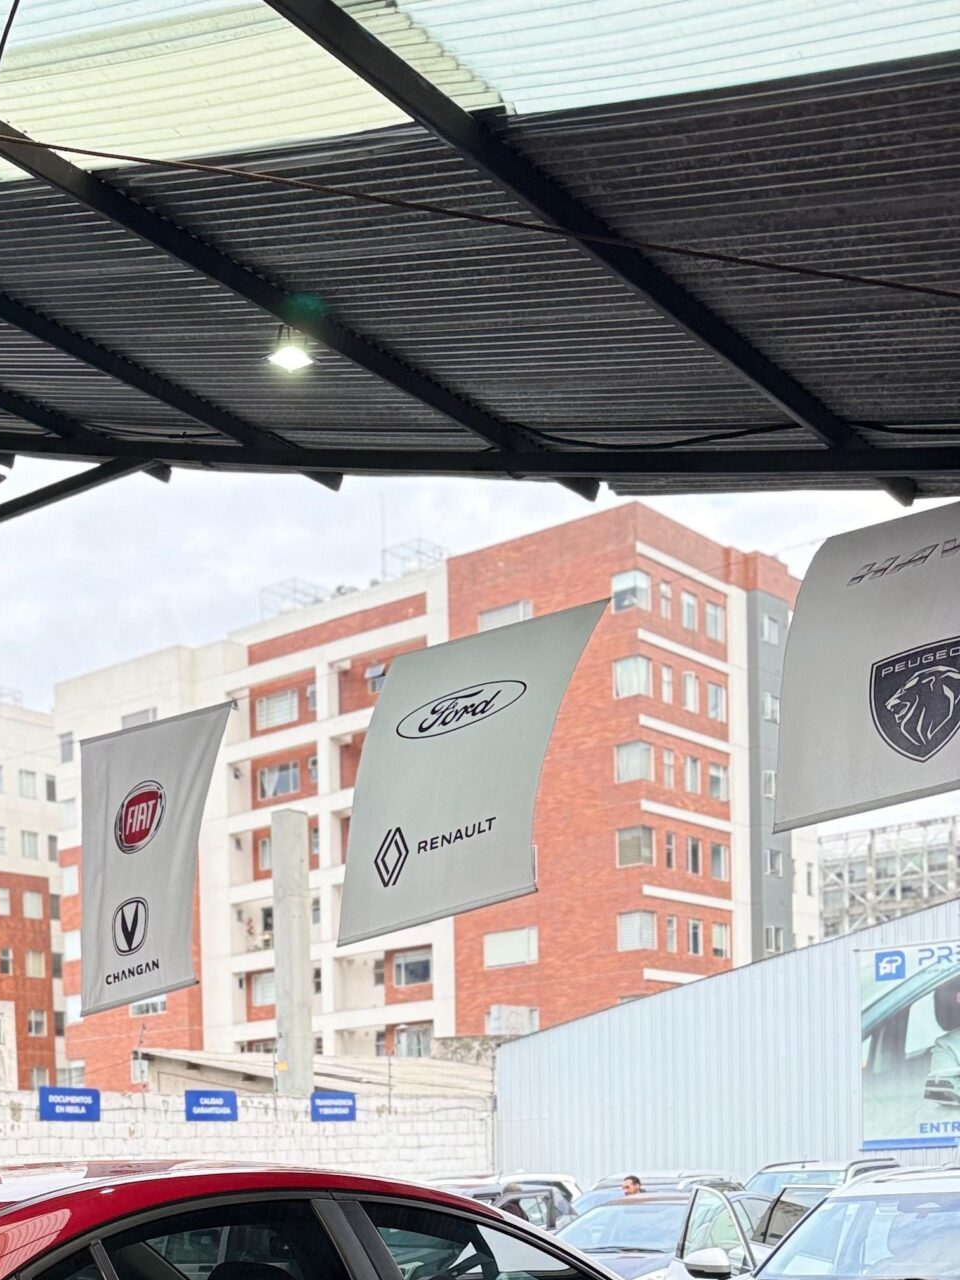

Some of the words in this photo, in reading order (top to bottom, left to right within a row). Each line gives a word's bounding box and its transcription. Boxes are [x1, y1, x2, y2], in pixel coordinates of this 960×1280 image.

[417, 688, 496, 734] Ford
[125, 799, 157, 838] FIAT
[417, 816, 497, 855] RENAULT
[105, 958, 160, 986] CHANGAN
[48, 1094, 93, 1104] DOCUMENTOS
